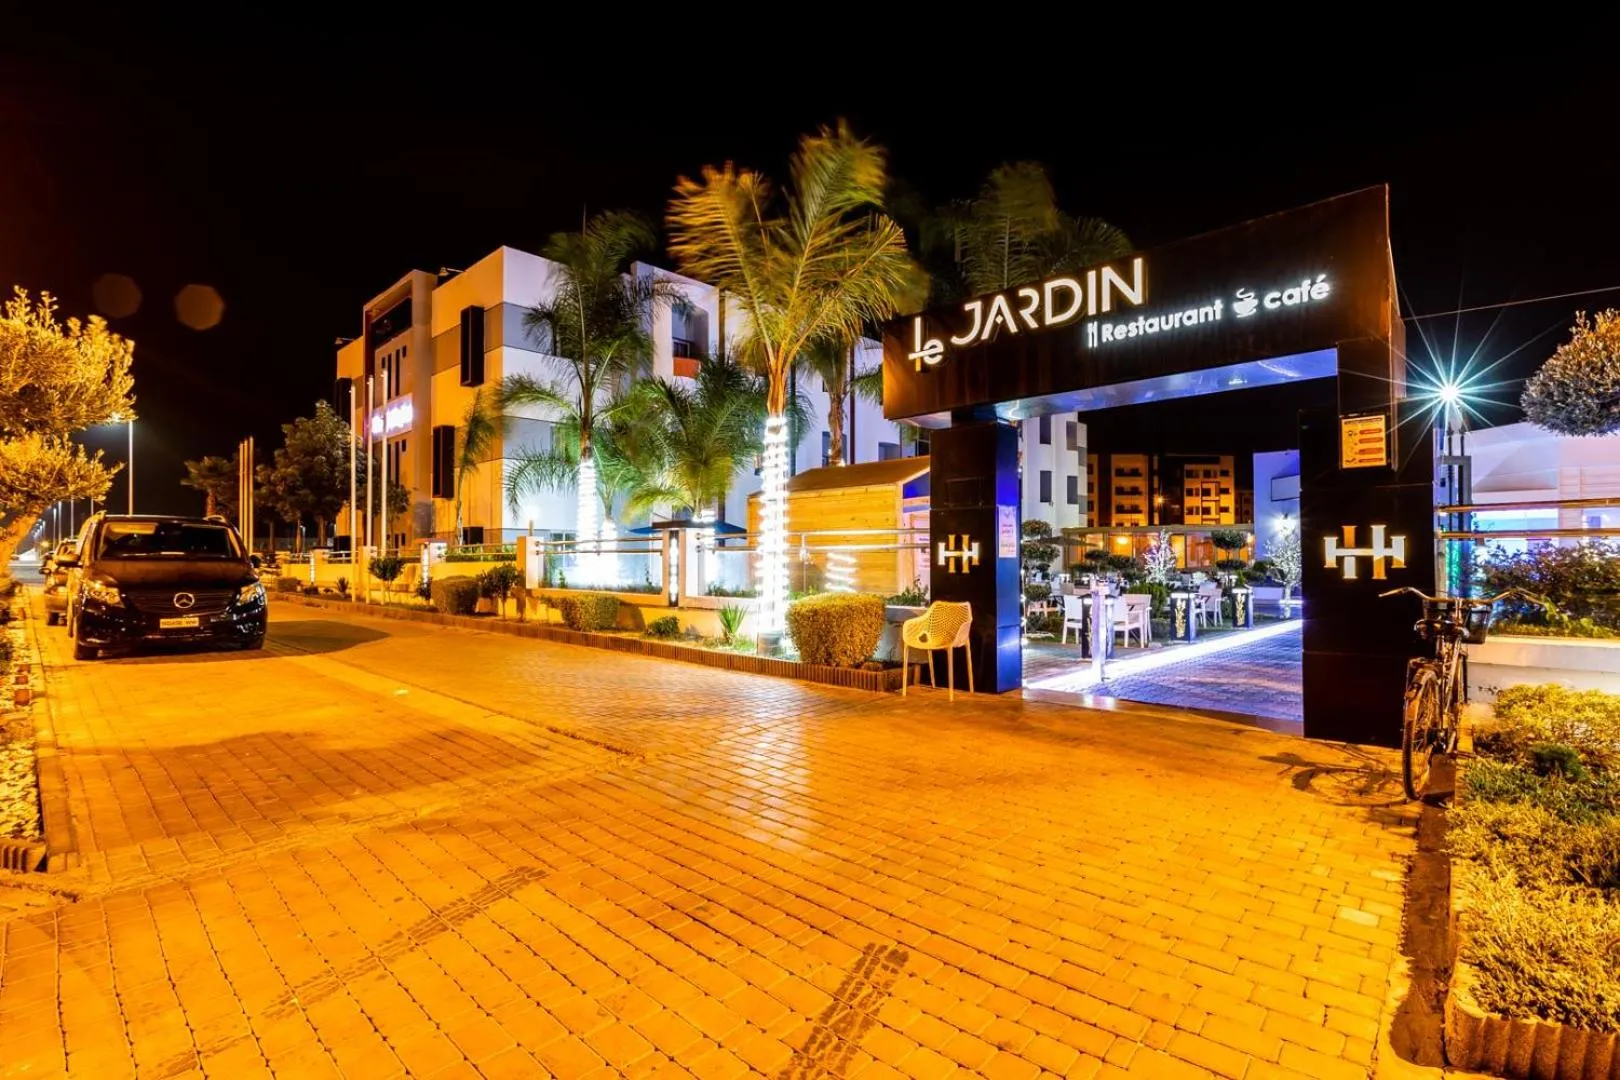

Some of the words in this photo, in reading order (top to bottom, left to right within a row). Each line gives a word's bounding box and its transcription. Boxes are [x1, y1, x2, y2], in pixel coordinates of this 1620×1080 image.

[951, 258, 1144, 345] JARDIN
[1102, 300, 1223, 342] Restaurant
[1263, 275, 1330, 310] café
